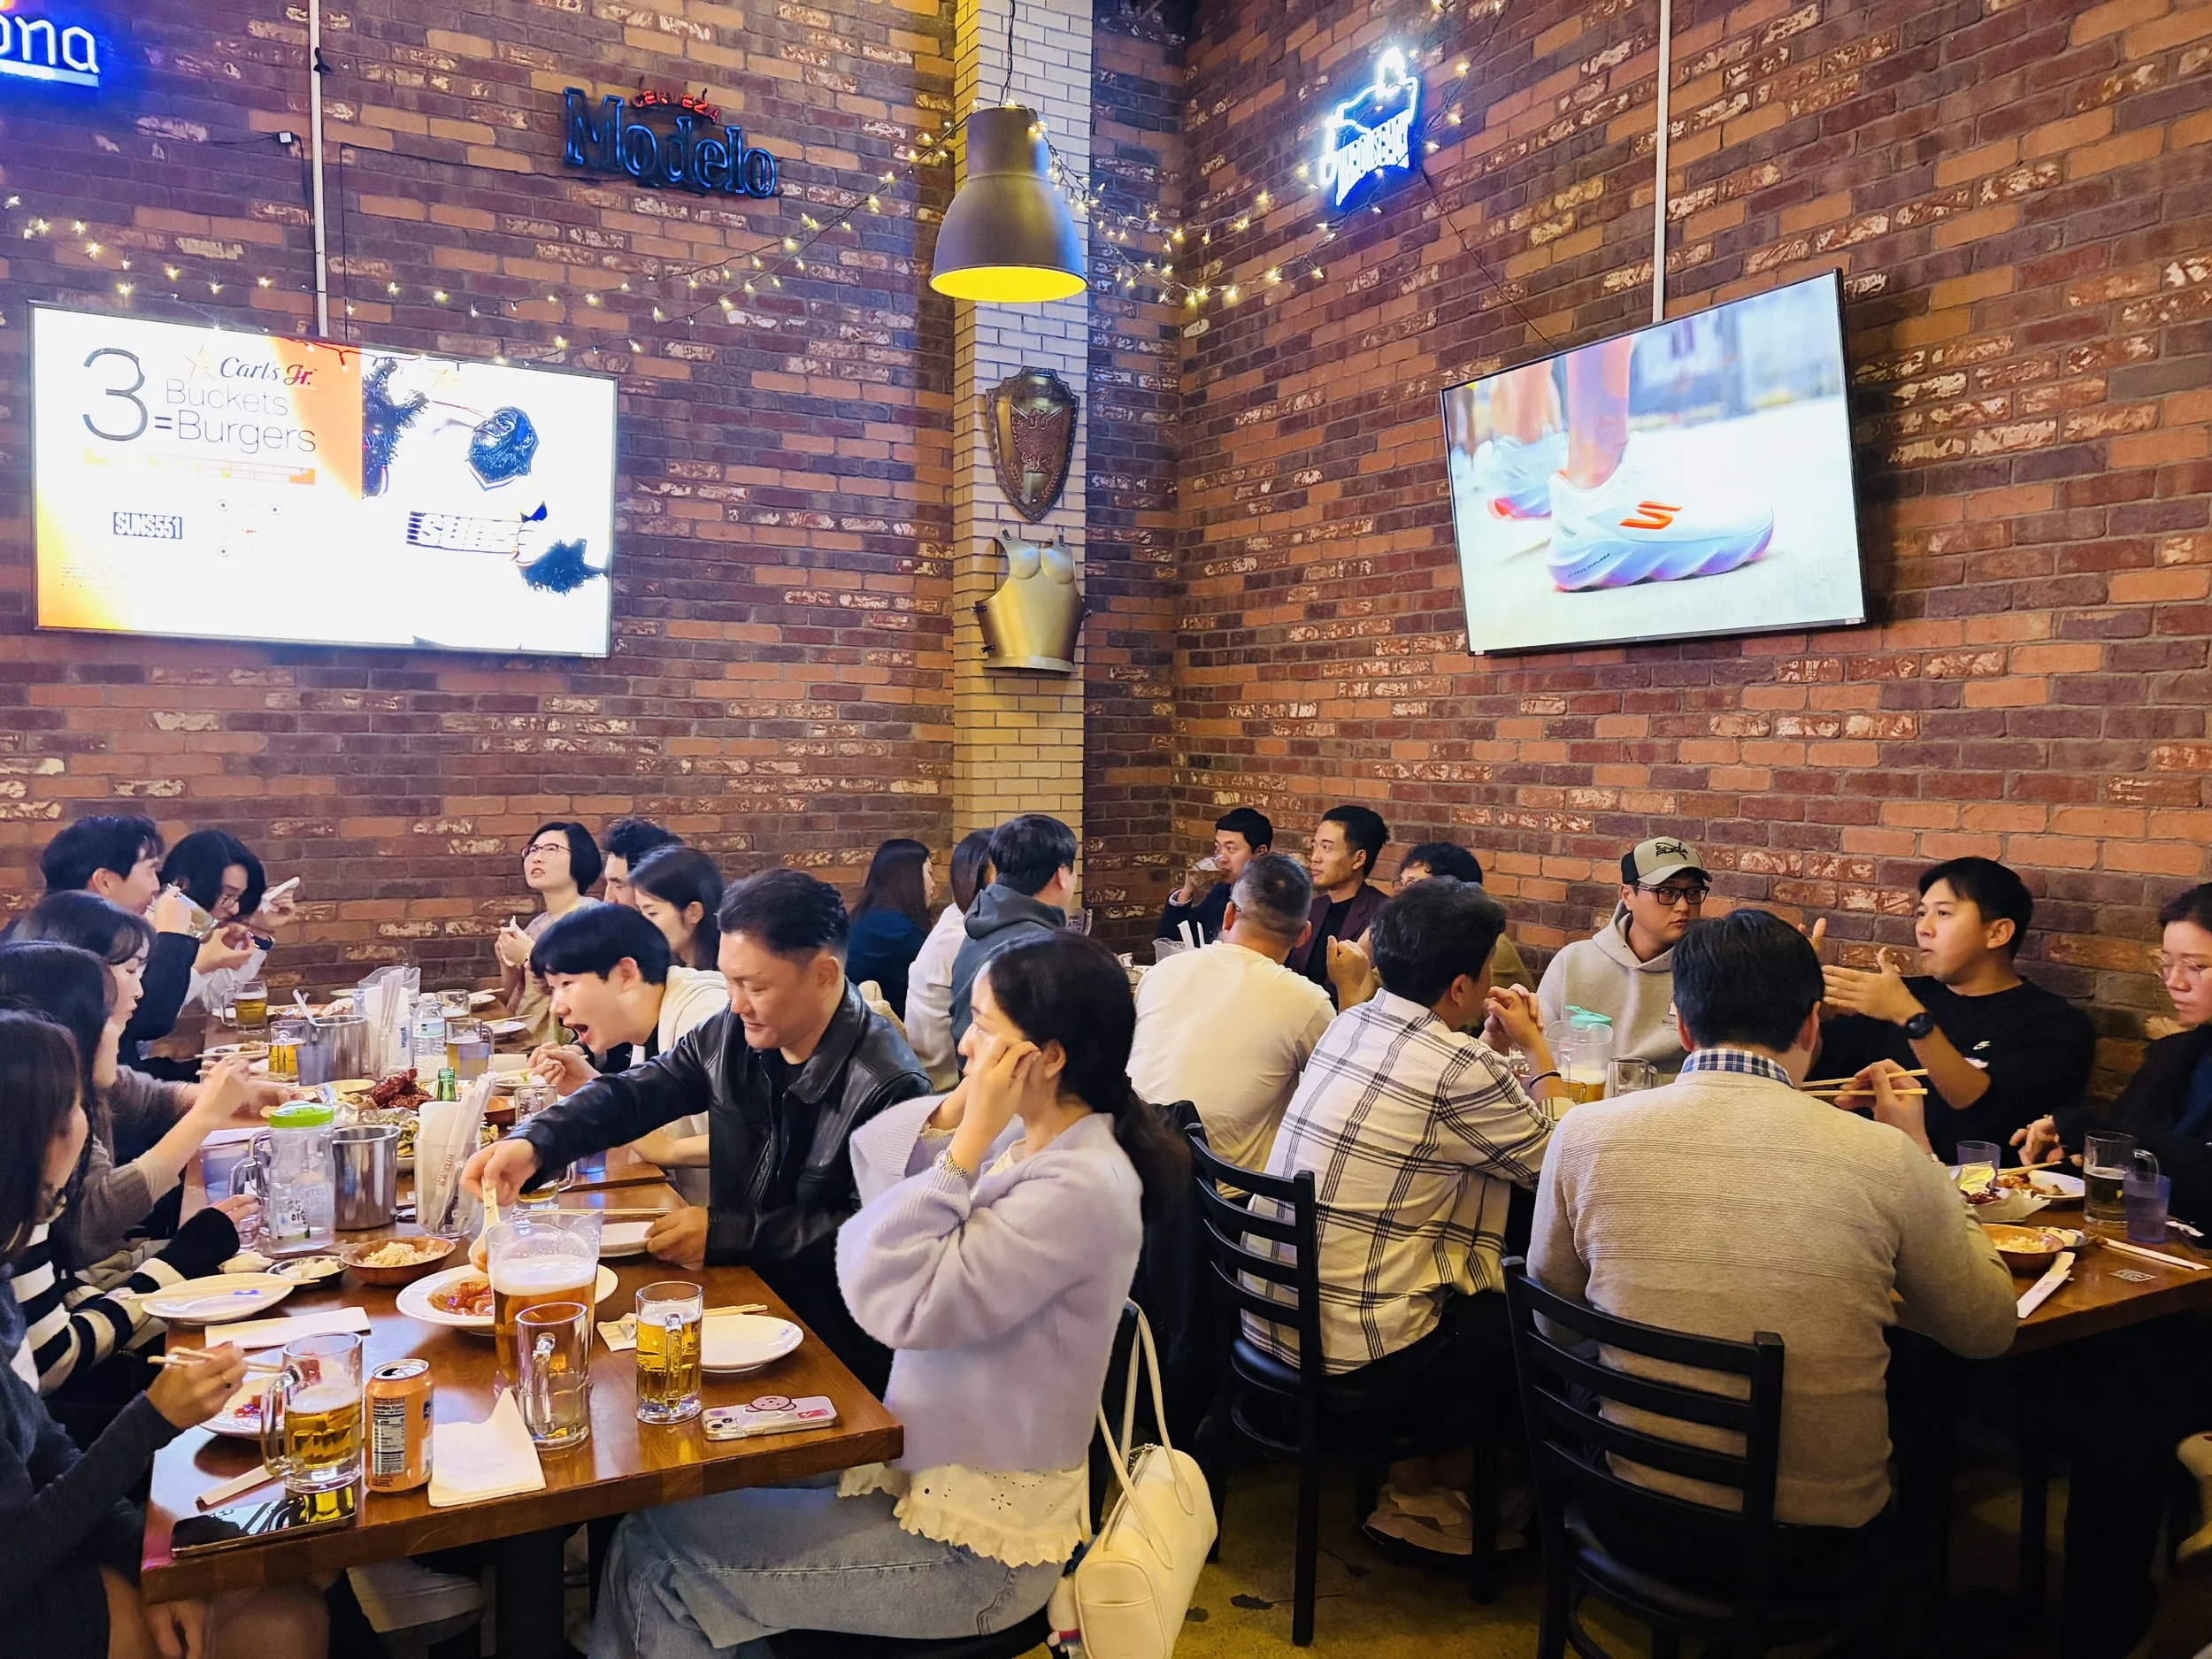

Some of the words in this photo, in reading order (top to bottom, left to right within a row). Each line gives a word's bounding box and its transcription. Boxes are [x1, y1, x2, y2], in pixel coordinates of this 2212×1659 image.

[563, 86, 777, 199] Modelo
[83, 348, 149, 442] 3
[165, 378, 289, 417] Buckets
[114, 512, 181, 539] SUNS551
